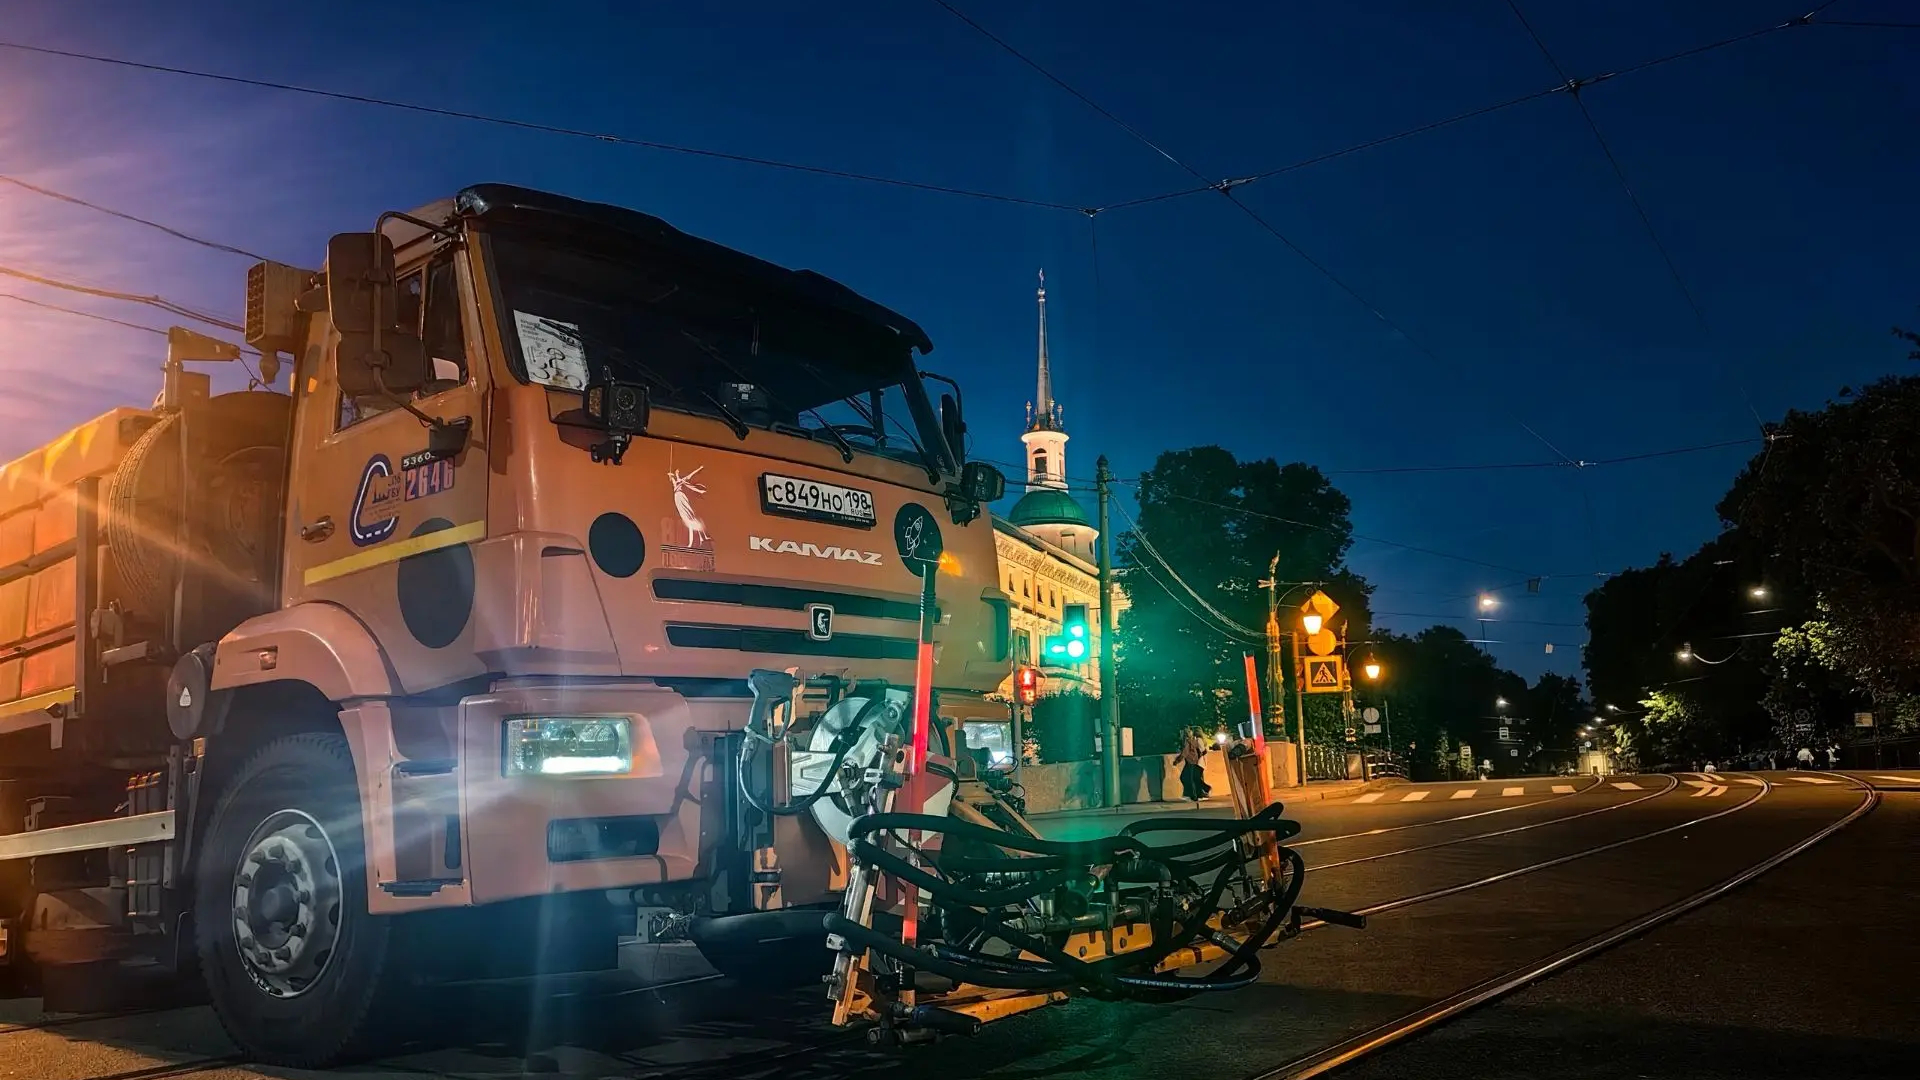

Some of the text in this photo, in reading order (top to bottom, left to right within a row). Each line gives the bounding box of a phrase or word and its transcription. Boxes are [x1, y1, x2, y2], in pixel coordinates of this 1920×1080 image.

[403, 451, 437, 467] 5360
[845, 491, 868, 510] 198
[850, 508, 864, 517] RUS
[750, 536, 883, 566] KAMAZ
